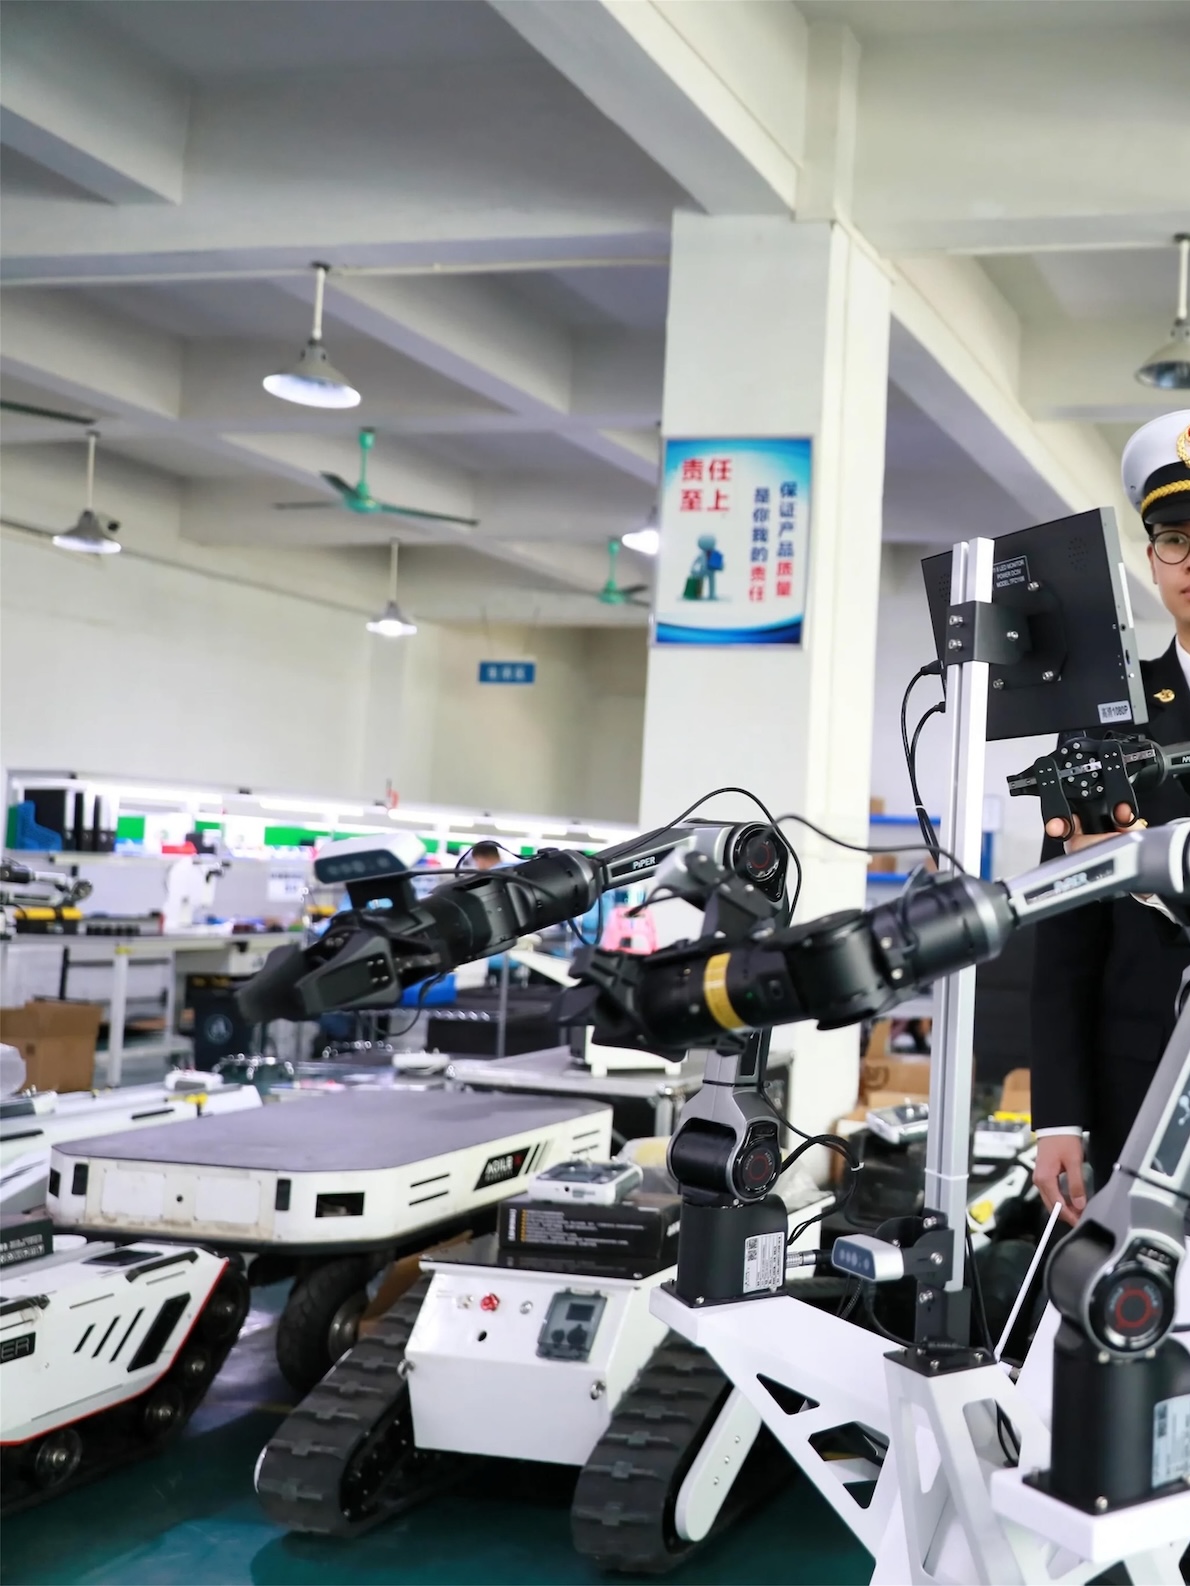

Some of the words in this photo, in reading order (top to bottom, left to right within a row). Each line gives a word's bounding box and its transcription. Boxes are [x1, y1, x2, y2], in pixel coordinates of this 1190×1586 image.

[680, 487, 730, 512] 至上
[681, 458, 731, 482] 责任
[748, 487, 770, 602] 是你我的责任
[776, 481, 798, 598] 保证产品质量
